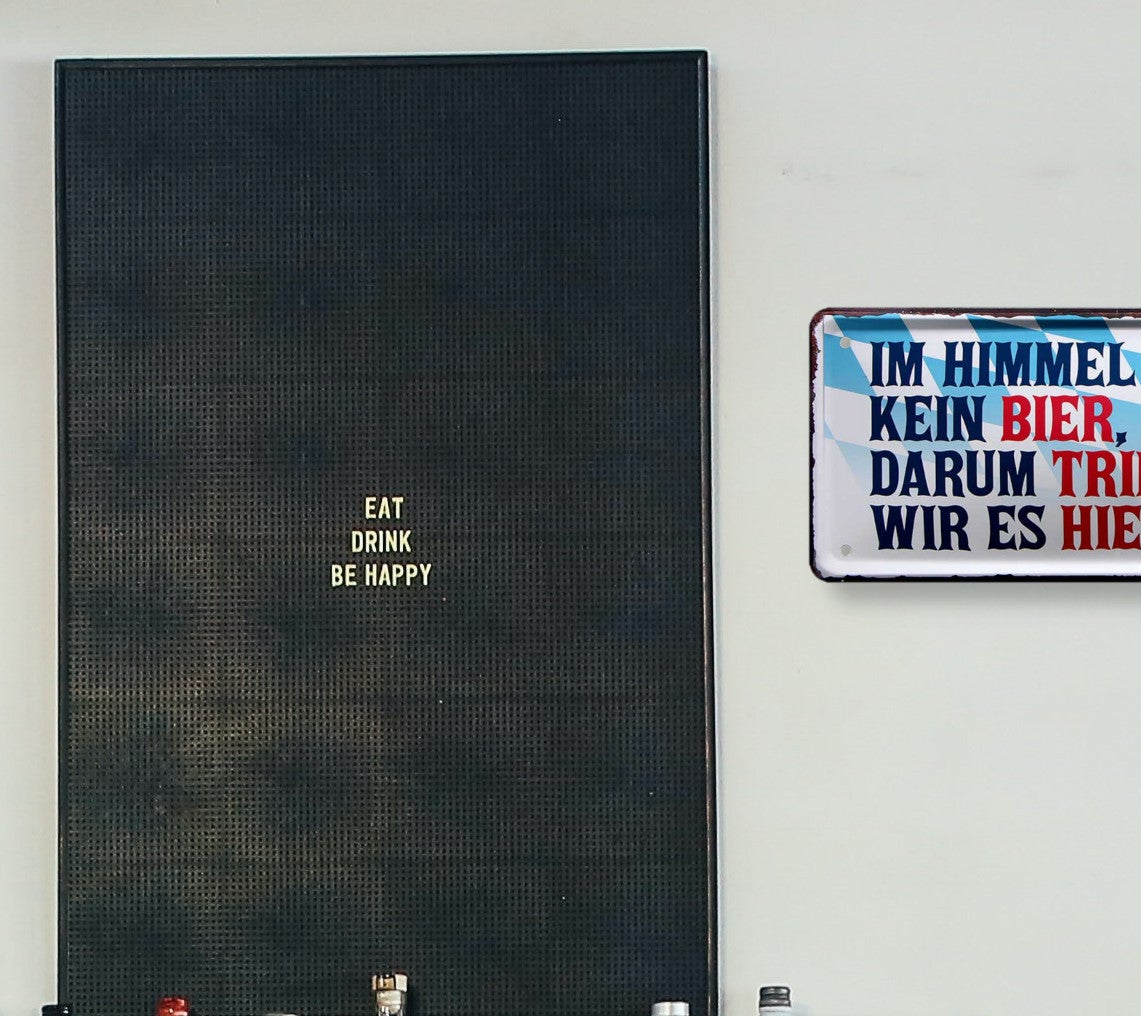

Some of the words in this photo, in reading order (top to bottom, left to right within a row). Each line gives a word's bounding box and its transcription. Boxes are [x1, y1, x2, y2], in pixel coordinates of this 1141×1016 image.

[869, 341, 925, 387] IM
[941, 341, 1137, 387] HIMMEL
[869, 395, 987, 442] KEIN
[1001, 395, 1129, 449] BIER,
[869, 450, 1038, 497] DARUM
[365, 496, 404, 520] EAT
[869, 504, 971, 551] WIR
[986, 504, 1047, 551] ES
[351, 529, 412, 553] DRINK
[331, 564, 357, 587] BE
[365, 563, 432, 587] HAPPY
